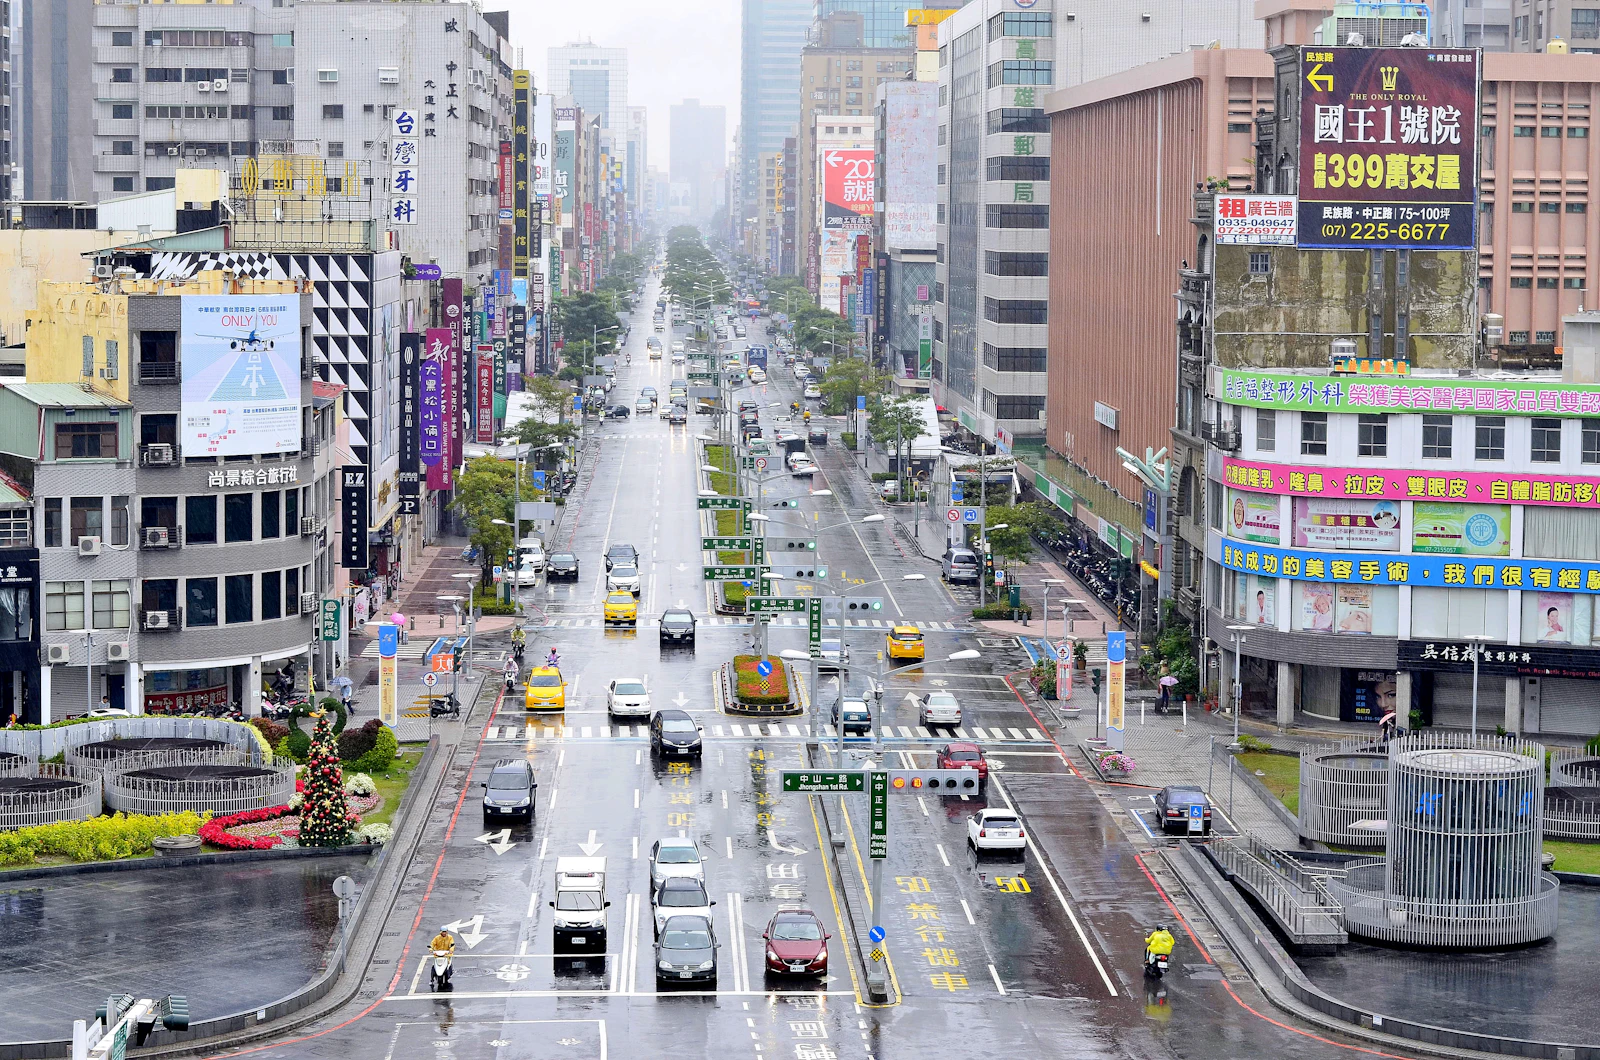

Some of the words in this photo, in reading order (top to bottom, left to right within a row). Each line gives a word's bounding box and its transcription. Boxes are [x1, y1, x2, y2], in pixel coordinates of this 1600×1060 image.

[1306, 52, 1334, 62] 民族路
[1014, 40, 1036, 202] 高雄郵局
[1314, 104, 1461, 145] 國王1號院
[394, 112, 416, 222] 台灣牙科
[1314, 152, 1326, 188] 自備
[1328, 154, 1460, 190] 399萬交屋
[1219, 198, 1246, 218] 租
[1248, 201, 1292, 216] 廣告牆
[1322, 224, 1346, 237] (07)
[1350, 222, 1450, 240] 225-6677
[221, 315, 254, 326] ONLY
[260, 314, 278, 326] YOU
[424, 364, 438, 450] 大黑松小倆口
[208, 466, 298, 488] 尚景綜合旅行社
[345, 473, 364, 484] EZ
[1226, 464, 1600, 502] 內視鏡隆乳、隆鼻、拉皮、雙眼皮、自體脂肪移
[404, 501, 415, 512] P
[0, 566, 17, 578] 堂
[1484, 651, 1531, 664] 整形外科
[800, 774, 848, 783] 中山一路
[874, 782, 883, 830] 中正三路
[870, 833, 886, 841] Jhong
[870, 841, 886, 849] Jheng
[895, 876, 932, 892] 50
[995, 876, 1032, 893] 50
[905, 902, 969, 992] 禁行機車
